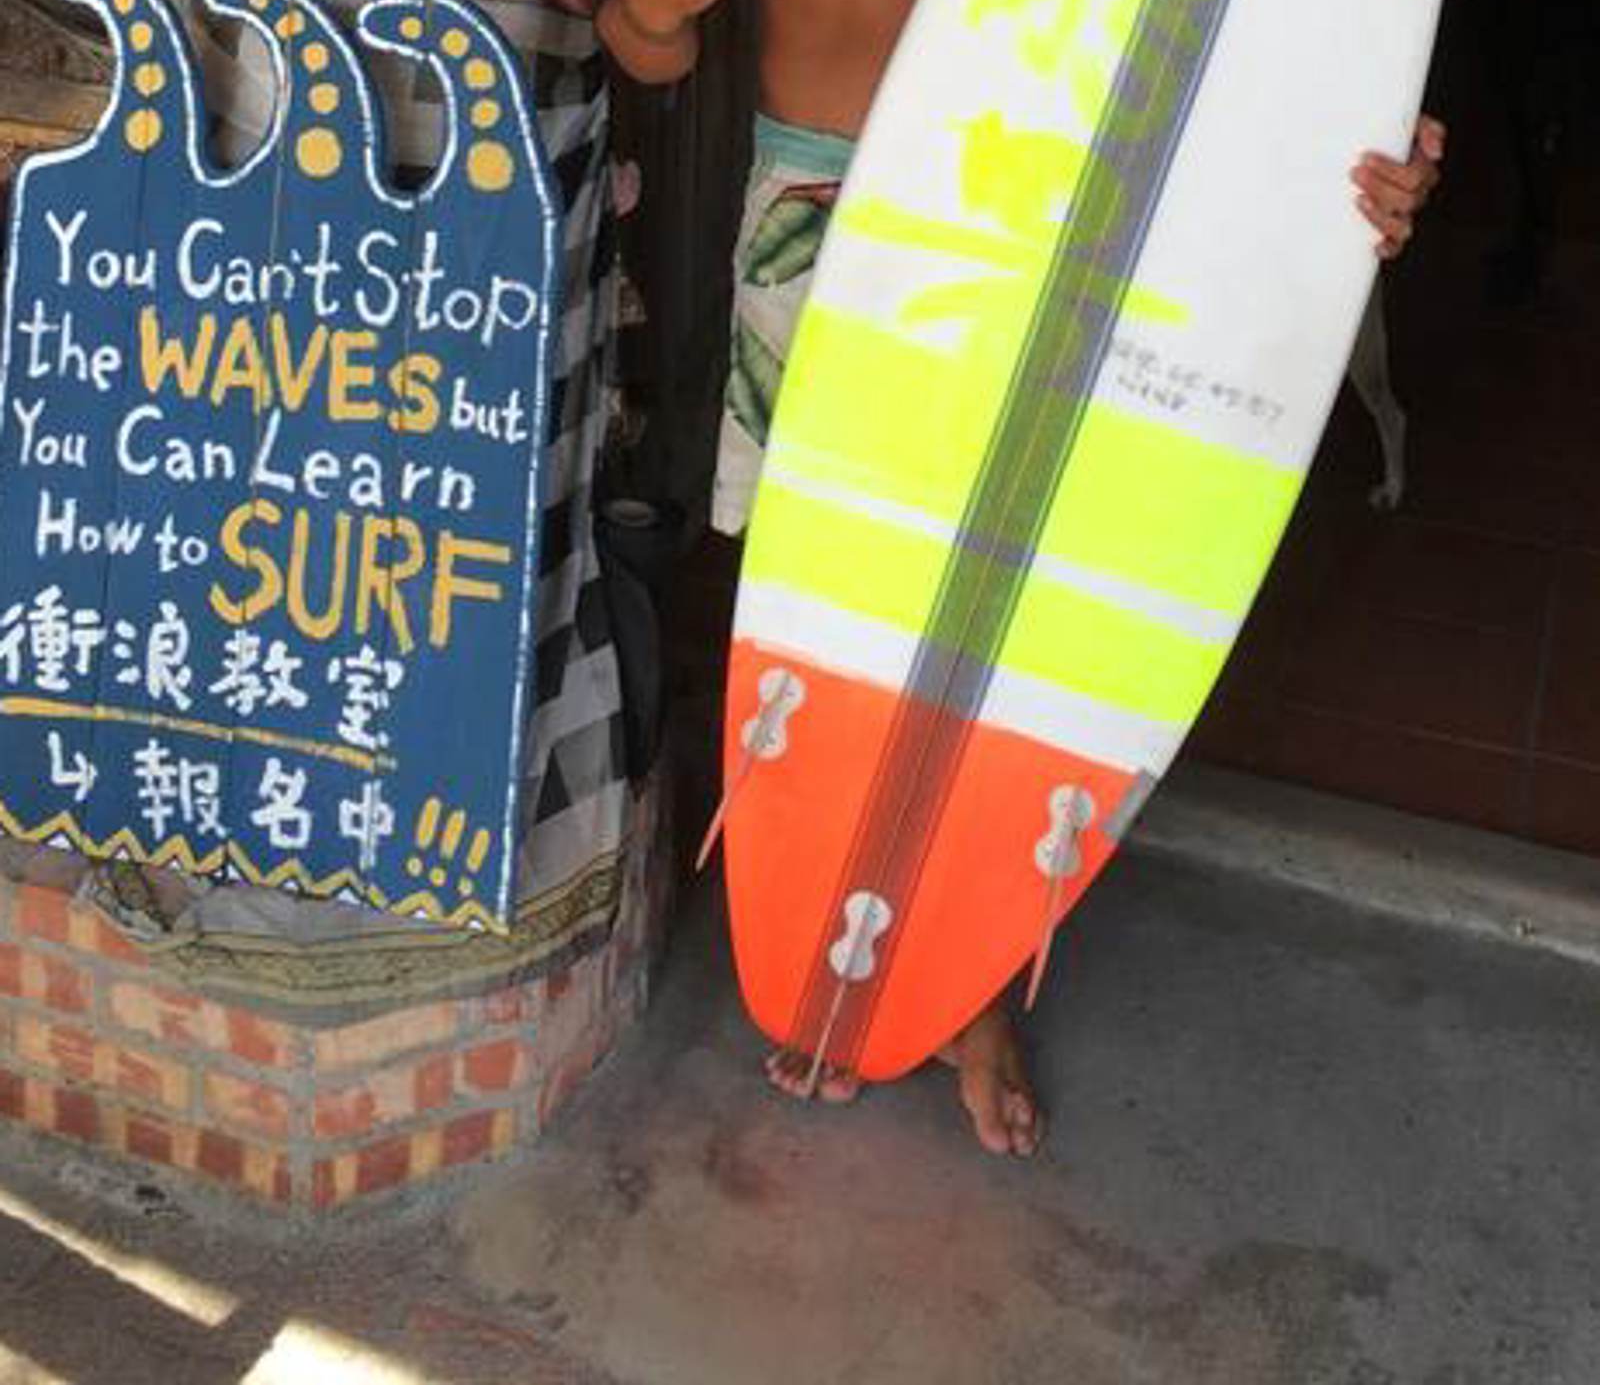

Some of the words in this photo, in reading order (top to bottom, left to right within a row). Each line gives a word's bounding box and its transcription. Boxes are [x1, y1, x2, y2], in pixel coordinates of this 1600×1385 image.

[45, 209, 157, 287] You
[177, 218, 341, 316] Can't
[354, 228, 539, 347] Stop
[17, 300, 122, 390] the
[137, 304, 443, 433] WAVES
[450, 378, 529, 445] but
[13, 397, 87, 466] You
[116, 404, 237, 483] Can
[249, 408, 476, 512] Learn
[35, 489, 146, 558] How
[154, 515, 210, 572] to
[208, 498, 512, 656] SURF
[0, 584, 403, 750] 衝浪教室
